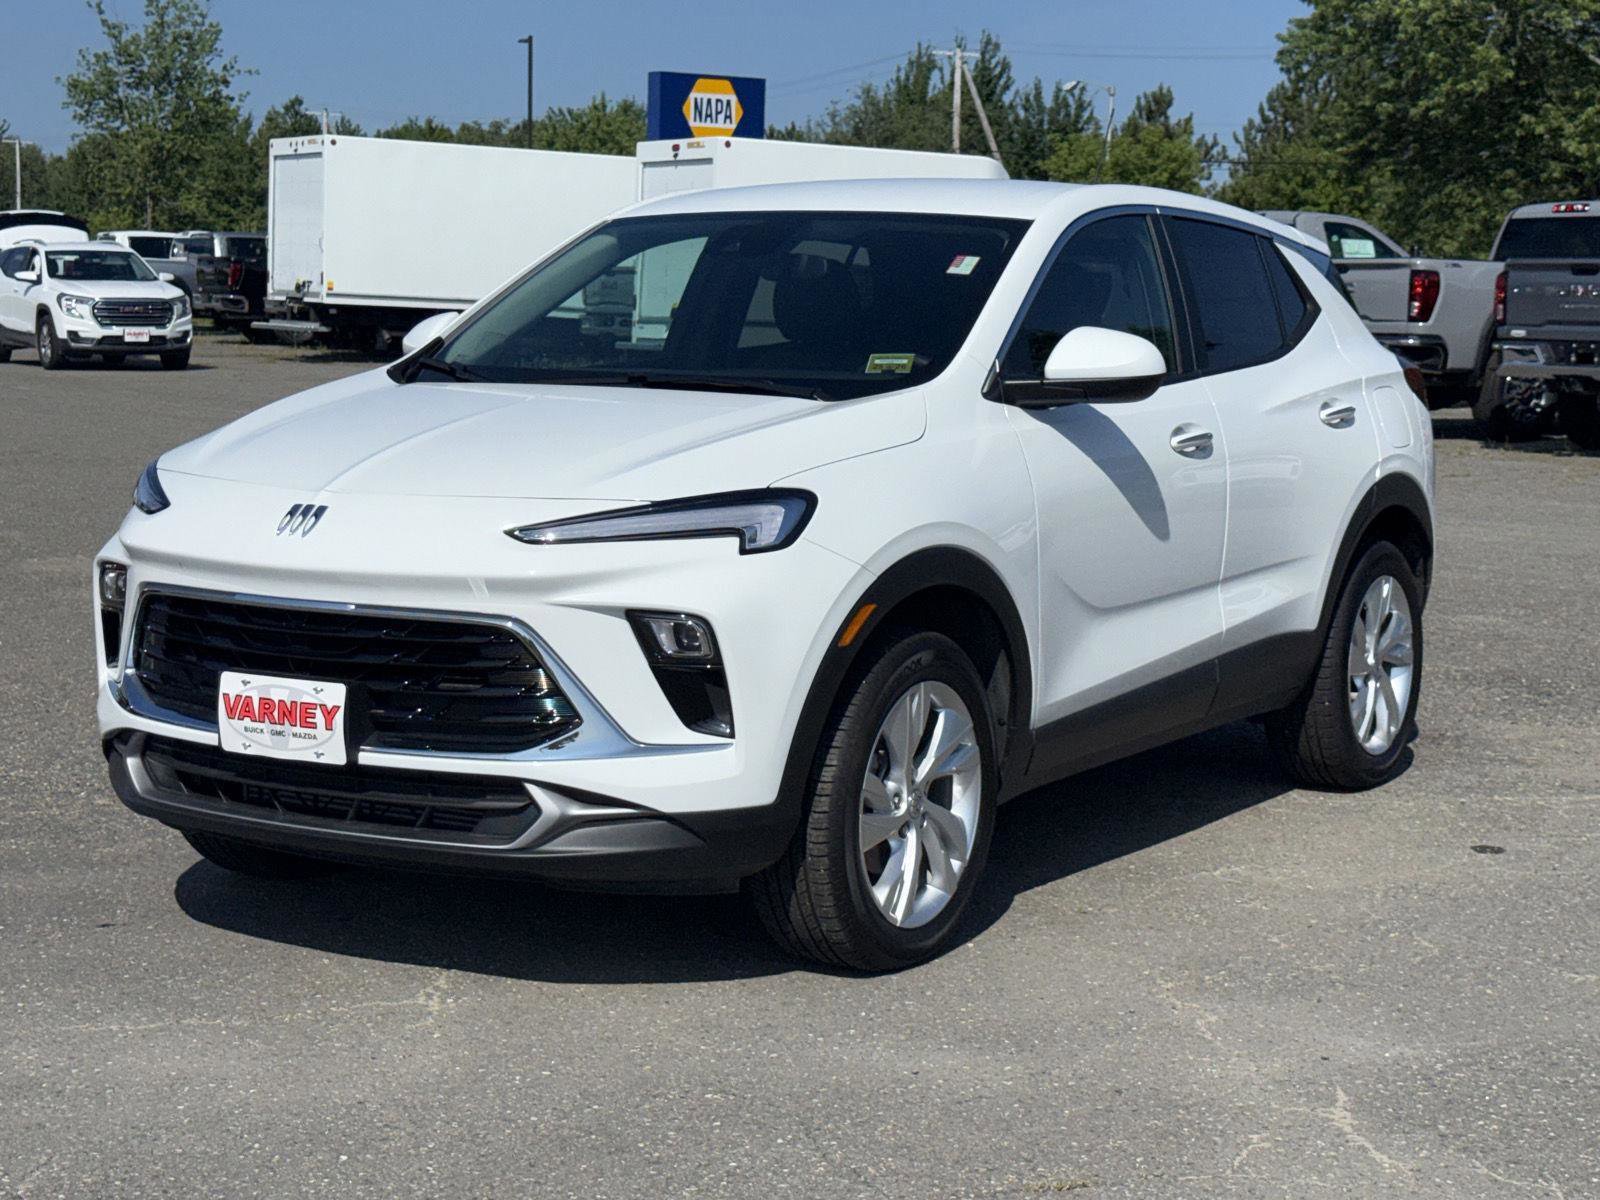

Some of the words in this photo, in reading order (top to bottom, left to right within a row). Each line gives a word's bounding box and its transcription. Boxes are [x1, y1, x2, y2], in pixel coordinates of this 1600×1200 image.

[693, 97, 733, 124] NAPA
[222, 692, 342, 731] VARNEY
[243, 726, 265, 735] BUICK
[270, 729, 286, 737] GMC
[291, 732, 318, 741] MAZDA
